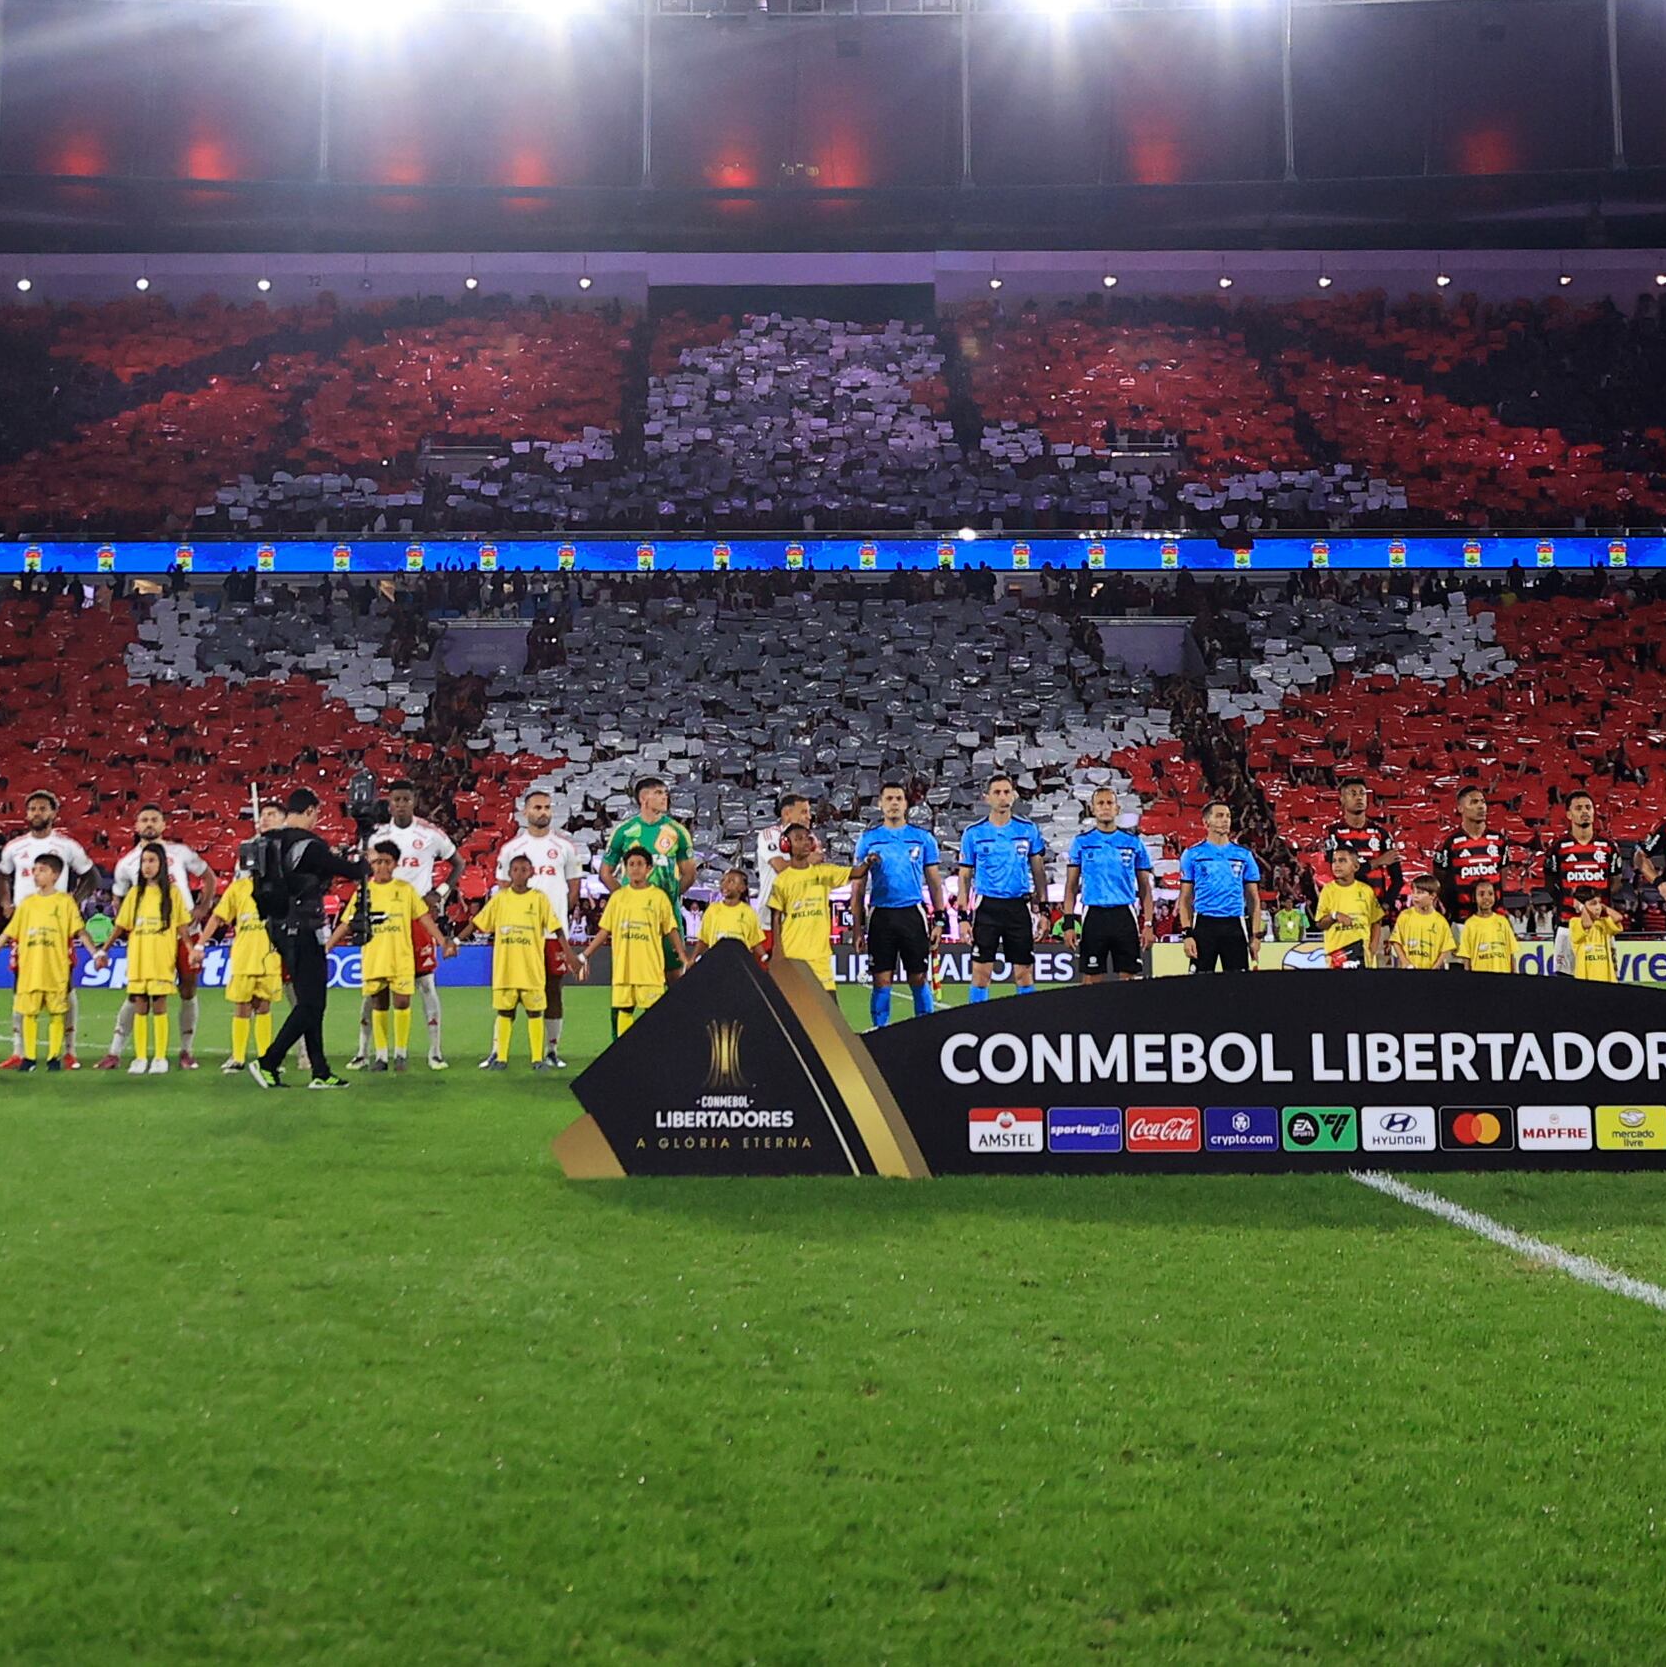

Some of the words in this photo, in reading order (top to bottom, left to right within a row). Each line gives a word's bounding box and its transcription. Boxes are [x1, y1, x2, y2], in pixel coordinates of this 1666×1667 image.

[1461, 863, 1499, 879] pixbet
[1566, 869, 1605, 883] pixbet
[939, 1032, 1294, 1084] CONMEBOL
[701, 1095, 750, 1108] CONMEBOL
[655, 1110, 794, 1129] LIBERTADORES
[1293, 1119, 1314, 1131] EA
[1050, 1123, 1120, 1137] sportingbet
[1130, 1117, 1196, 1142] Coca-Cola
[1522, 1127, 1587, 1139] MAPFRE
[1612, 1130, 1655, 1139] mercado
[636, 1137, 646, 1149] A
[658, 1135, 730, 1149] GLÓRIA
[743, 1137, 813, 1149] ETERNA
[978, 1133, 1035, 1148] AMSTEL
[1210, 1133, 1274, 1147] crypto.com
[1372, 1136, 1426, 1146] HYUNDAI
[1624, 1138, 1644, 1148] livre
